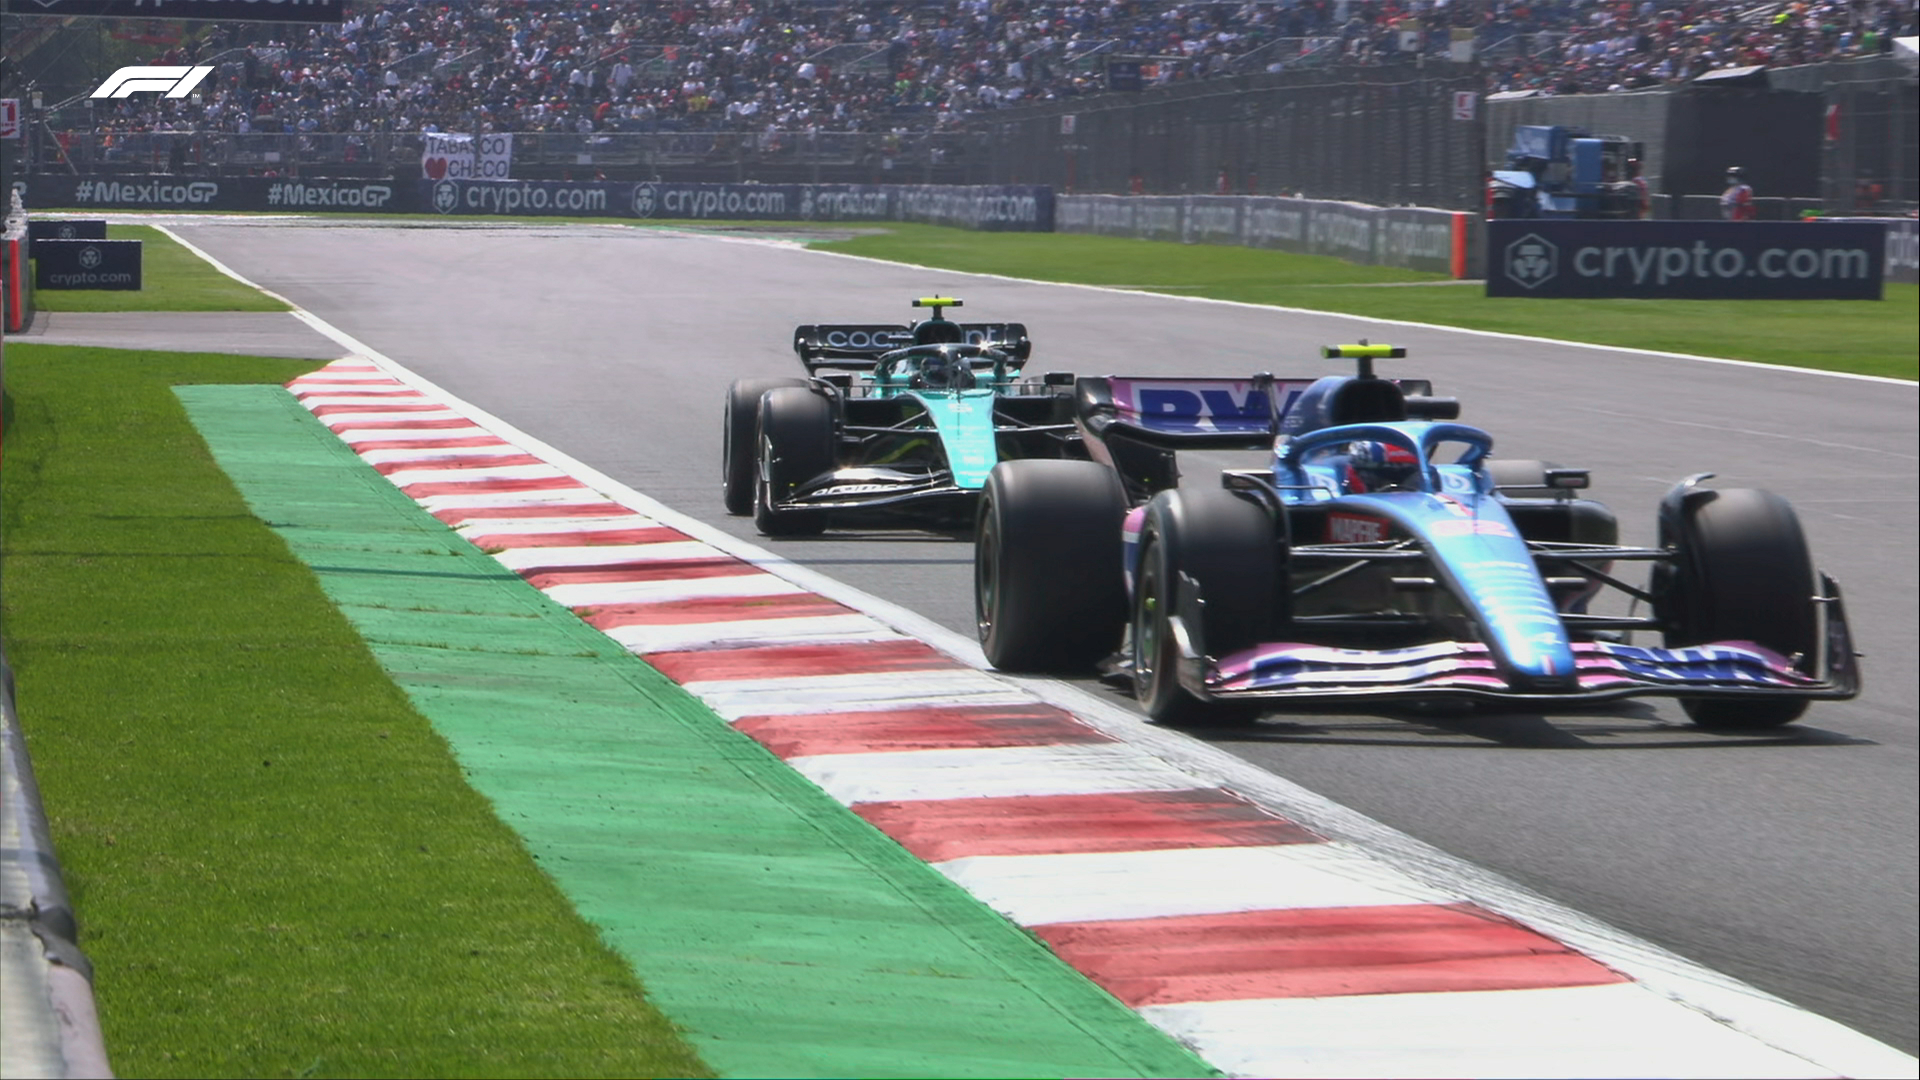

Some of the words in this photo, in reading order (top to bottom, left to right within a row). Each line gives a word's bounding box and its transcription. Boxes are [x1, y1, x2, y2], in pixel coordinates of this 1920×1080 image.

[75, 181, 218, 203] #MexicoGP
[267, 183, 392, 206] #MexicoGP
[466, 183, 606, 213] crypto.com
[664, 187, 785, 217] crypto.com
[1573, 240, 1868, 285] crypto.com
[50, 272, 131, 285] crypto.com
